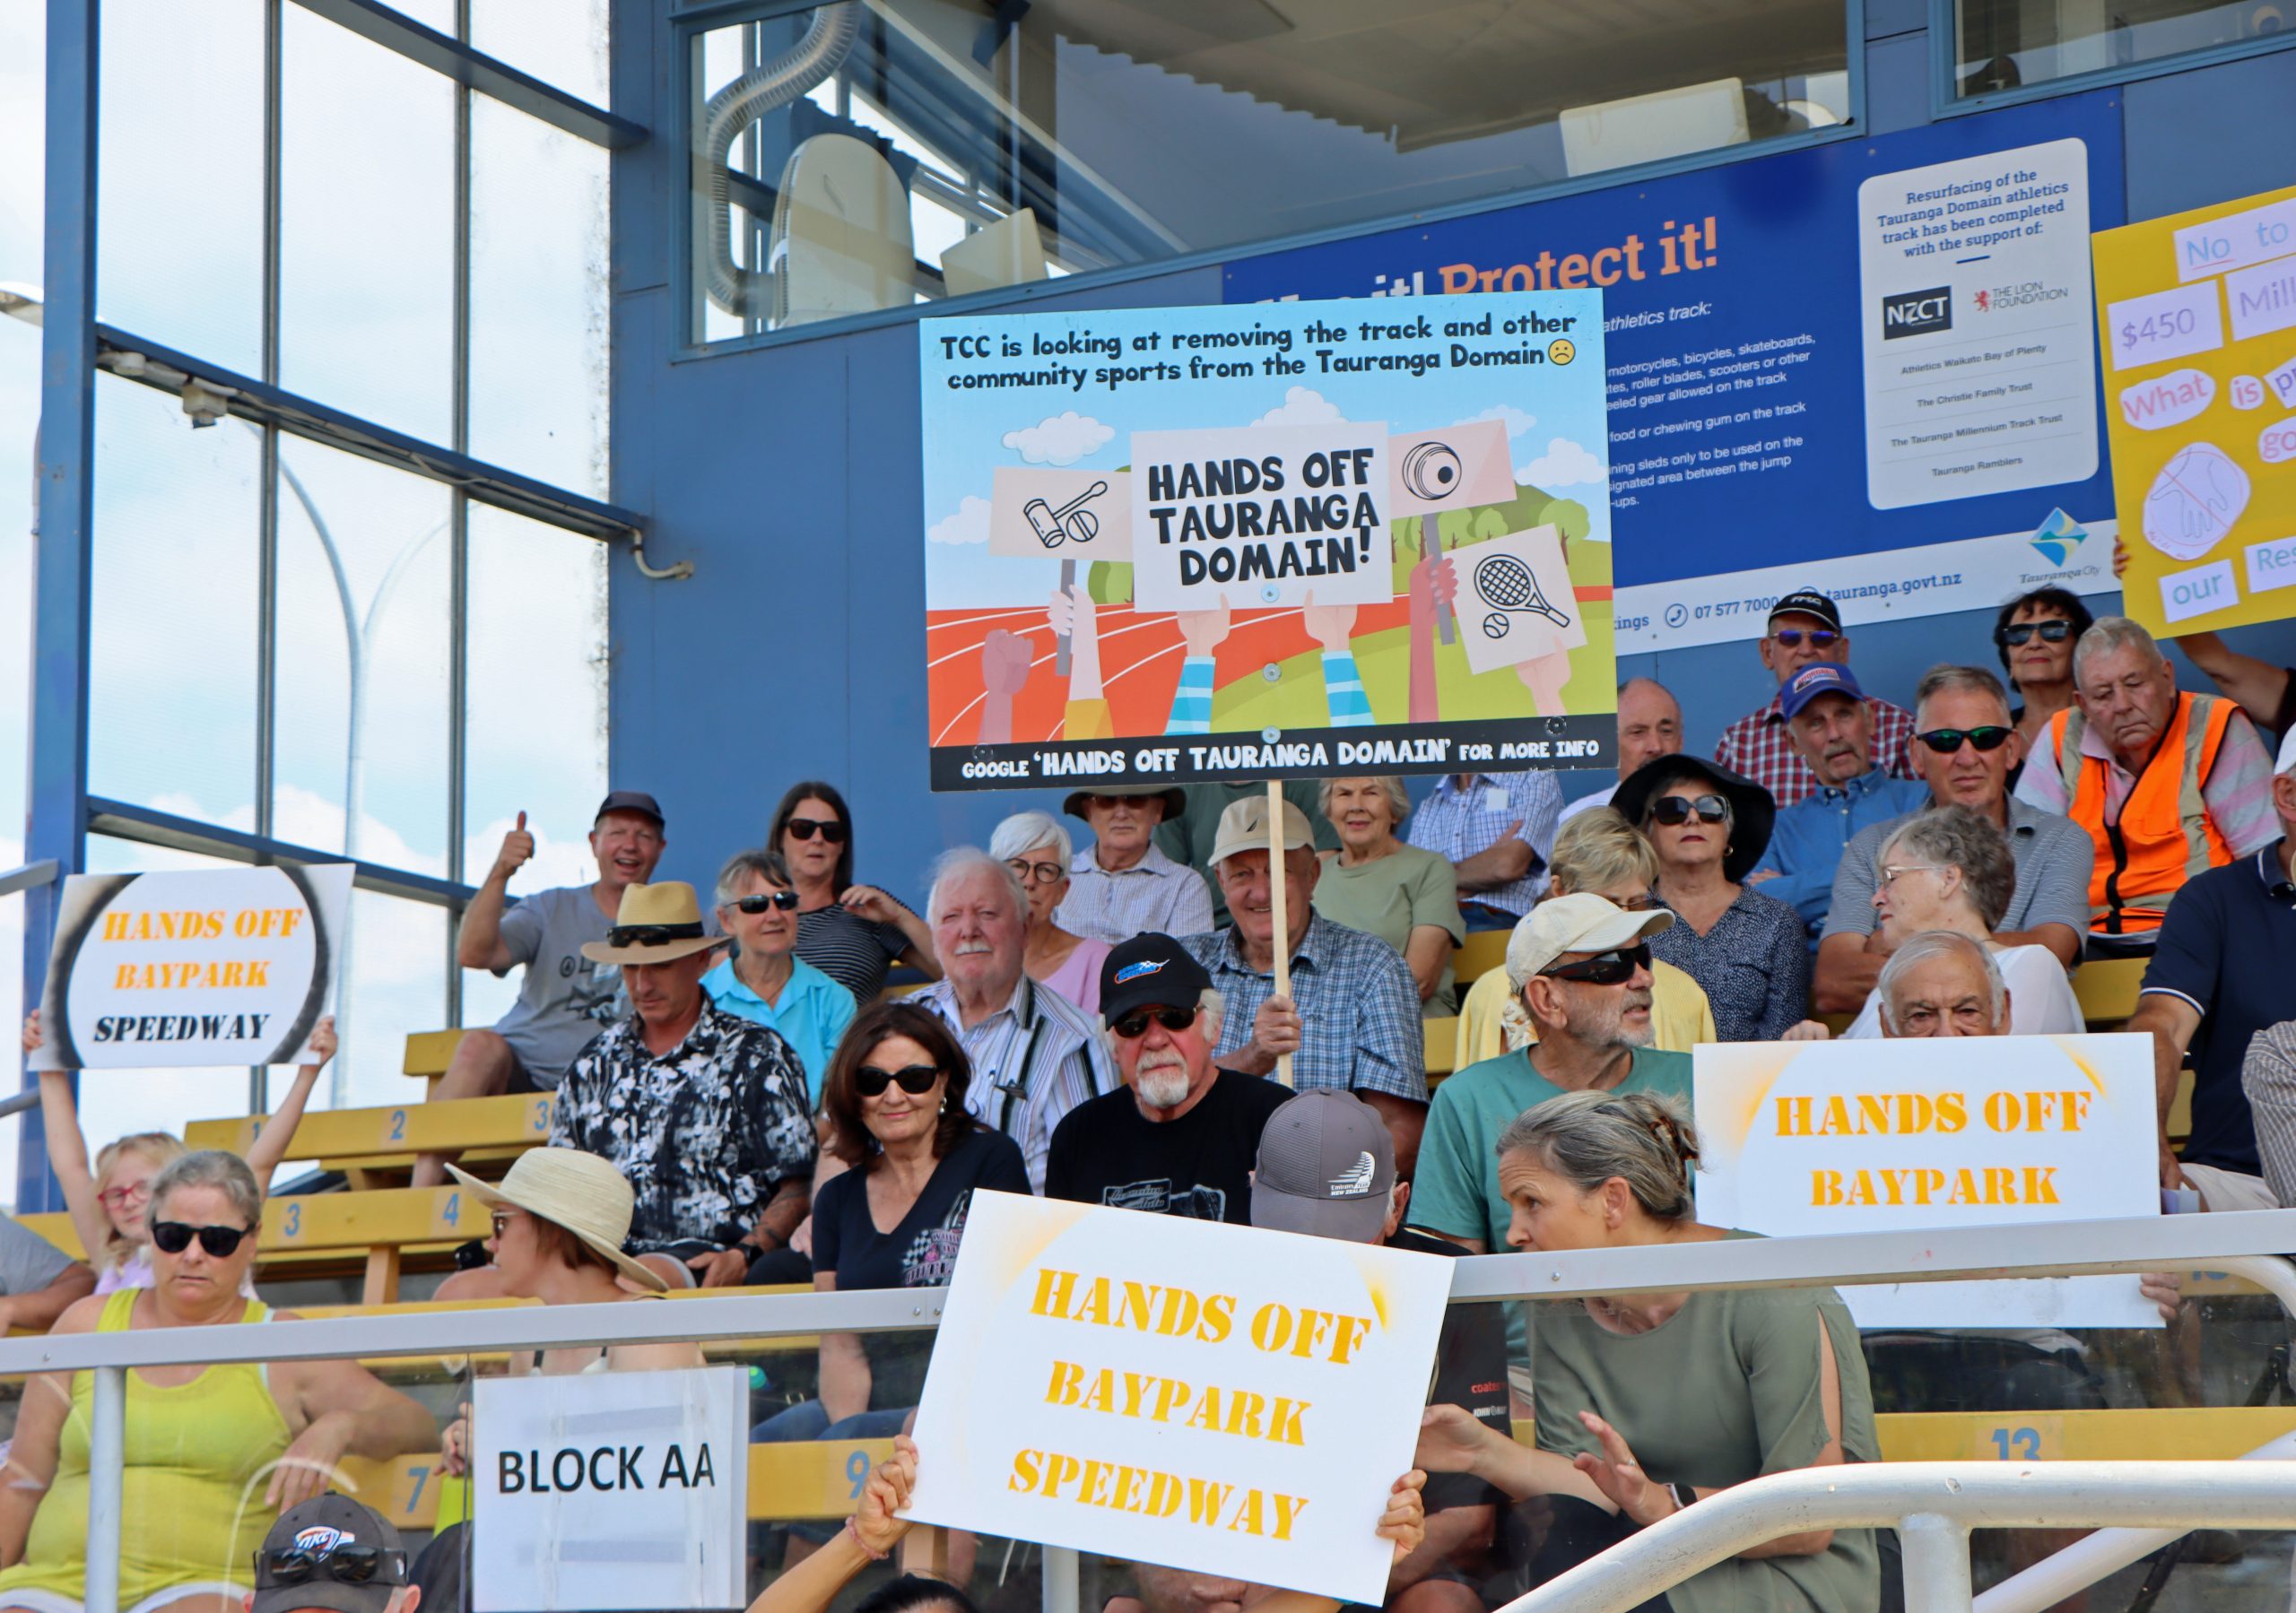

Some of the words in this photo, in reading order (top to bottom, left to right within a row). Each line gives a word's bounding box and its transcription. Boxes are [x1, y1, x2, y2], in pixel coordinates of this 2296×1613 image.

[1877, 207, 1944, 228] Tauranga
[1947, 194, 2002, 215] Domain
[2005, 182, 2069, 204] athletics
[1906, 181, 1992, 205] Resurfacing
[1996, 173, 2012, 187] of
[2013, 169, 2038, 185] the
[1882, 224, 1918, 244] track
[1922, 221, 1948, 238] has
[1951, 213, 1986, 231] been
[1988, 198, 2066, 225] completed
[1903, 241, 1935, 258] with
[1939, 235, 1962, 251] the
[1965, 226, 2022, 247] support
[2025, 221, 2044, 236] of:
[1439, 233, 1645, 294] Protect
[1658, 215, 1718, 277] it!
[2187, 237, 2231, 266] No
[2256, 221, 2290, 248] to
[1992, 285, 2013, 298] THE
[2015, 281, 2044, 295] LION
[1992, 287, 2068, 310] FOUNDATION
[1605, 310, 1665, 334] athletics
[1669, 301, 1712, 321] track:
[1887, 296, 1949, 325] NZCT
[2122, 308, 2196, 350] $450
[941, 335, 990, 360] TCC
[1002, 335, 1022, 357] is
[1033, 331, 1123, 360] looking
[1132, 329, 1161, 351] at
[1171, 324, 1294, 352] removing
[1304, 319, 1348, 344] the
[1358, 316, 1433, 341] track
[1444, 314, 1493, 337] and
[1502, 311, 1578, 334] other
[1607, 355, 1682, 377] motorcycles,
[1683, 346, 1736, 366] bicycles,
[1738, 333, 1816, 356] skateboards,
[948, 365, 1089, 391] community
[1096, 358, 1182, 391] sports
[1189, 356, 1255, 380] from
[1262, 353, 1307, 377] the
[1316, 346, 1441, 375] Tauranga
[1450, 342, 1545, 369] Domain
[1631, 377, 1661, 390] roller
[1664, 369, 1706, 386] blades,
[1709, 360, 1761, 377] scooters
[1763, 358, 1777, 369] or
[1779, 350, 1811, 367] other
[1901, 361, 1942, 376] Athletics
[1944, 354, 1982, 368] Waikato
[1984, 351, 2003, 363] Bay
[2005, 349, 2015, 358] of
[2017, 343, 2048, 357] Plenty
[1639, 392, 1665, 408] gear
[1668, 382, 1713, 402] allowed
[1717, 381, 1732, 394] on
[1734, 377, 1754, 390] the
[1756, 371, 1787, 386] track
[1917, 398, 1935, 409] The
[1936, 392, 1973, 406] Christie
[1975, 386, 2007, 400] Family
[2009, 382, 2033, 395] Trust
[2123, 374, 2209, 421] What
[2233, 379, 2260, 406] is
[1609, 428, 1636, 442] food
[1639, 426, 1652, 438] or
[1653, 418, 1702, 437] chewing
[1706, 415, 1732, 430] gum
[1735, 412, 1751, 423] on
[1752, 406, 1773, 421] the
[1775, 401, 1806, 416] track
[1891, 438, 1909, 448] The
[1911, 431, 1954, 446] Tauranga
[1956, 422, 2008, 438] Millennium
[2009, 417, 2037, 430] Track
[2039, 414, 2064, 426] Trust
[1639, 455, 1669, 471] sleds
[1672, 452, 1697, 468] only
[1699, 450, 1711, 461] to
[1714, 445, 1730, 458] be
[1733, 439, 1762, 455] used
[1765, 438, 1780, 450] on
[1783, 434, 1804, 447] the
[1657, 472, 1683, 486] area
[1685, 464, 1736, 481] between
[1739, 457, 1759, 472] the
[1761, 455, 1792, 472] jump
[1932, 464, 1976, 478] Tauranga
[1978, 456, 2024, 472] Ramblers
[1148, 455, 1285, 502] HANDS
[1301, 447, 1374, 490] OFF
[1150, 491, 1380, 544] TAURANGA
[1179, 525, 1371, 587] DOMAIN!
[2019, 568, 2082, 585] Tauranga
[2083, 564, 2102, 577] City
[1827, 573, 1962, 602] tauranga.govt.nz
[2172, 574, 2223, 605] our
[1614, 614, 1650, 631] ings
[1694, 605, 1713, 620] 07
[1716, 602, 1742, 618] 577
[1744, 596, 1779, 613] 7000
[961, 757, 1029, 779] GOOGLE
[1135, 744, 1178, 772] OFF
[1192, 740, 1329, 769] TAURANGA
[1459, 743, 1494, 761] FOR
[1499, 741, 1551, 759] MORE
[1556, 738, 1600, 757] INFO
[102, 909, 224, 941] HANDS
[232, 907, 305, 938] OFF
[113, 960, 272, 991] BAYPARK
[93, 1013, 271, 1042] SPEEDWAY
[390, 1109, 407, 1142] 2
[533, 1099, 550, 1133] 3
[1773, 1092, 1969, 1138] HANDS
[1983, 1090, 2093, 1133] OFF
[1809, 1166, 2061, 1208] BAYPARK
[283, 1202, 300, 1237] 3
[442, 1192, 459, 1227] 4
[1030, 1267, 1238, 1345] HANDS
[1250, 1303, 1372, 1366] OFF
[1043, 1359, 1314, 1447] BAYPARK
[1991, 1427, 2041, 1461] 13
[406, 1465, 430, 1514] 7
[846, 1450, 871, 1501] 9
[498, 1444, 645, 1494] BLOCK
[658, 1442, 717, 1489] AA
[1008, 1447, 1309, 1541] SPEEDWAY
